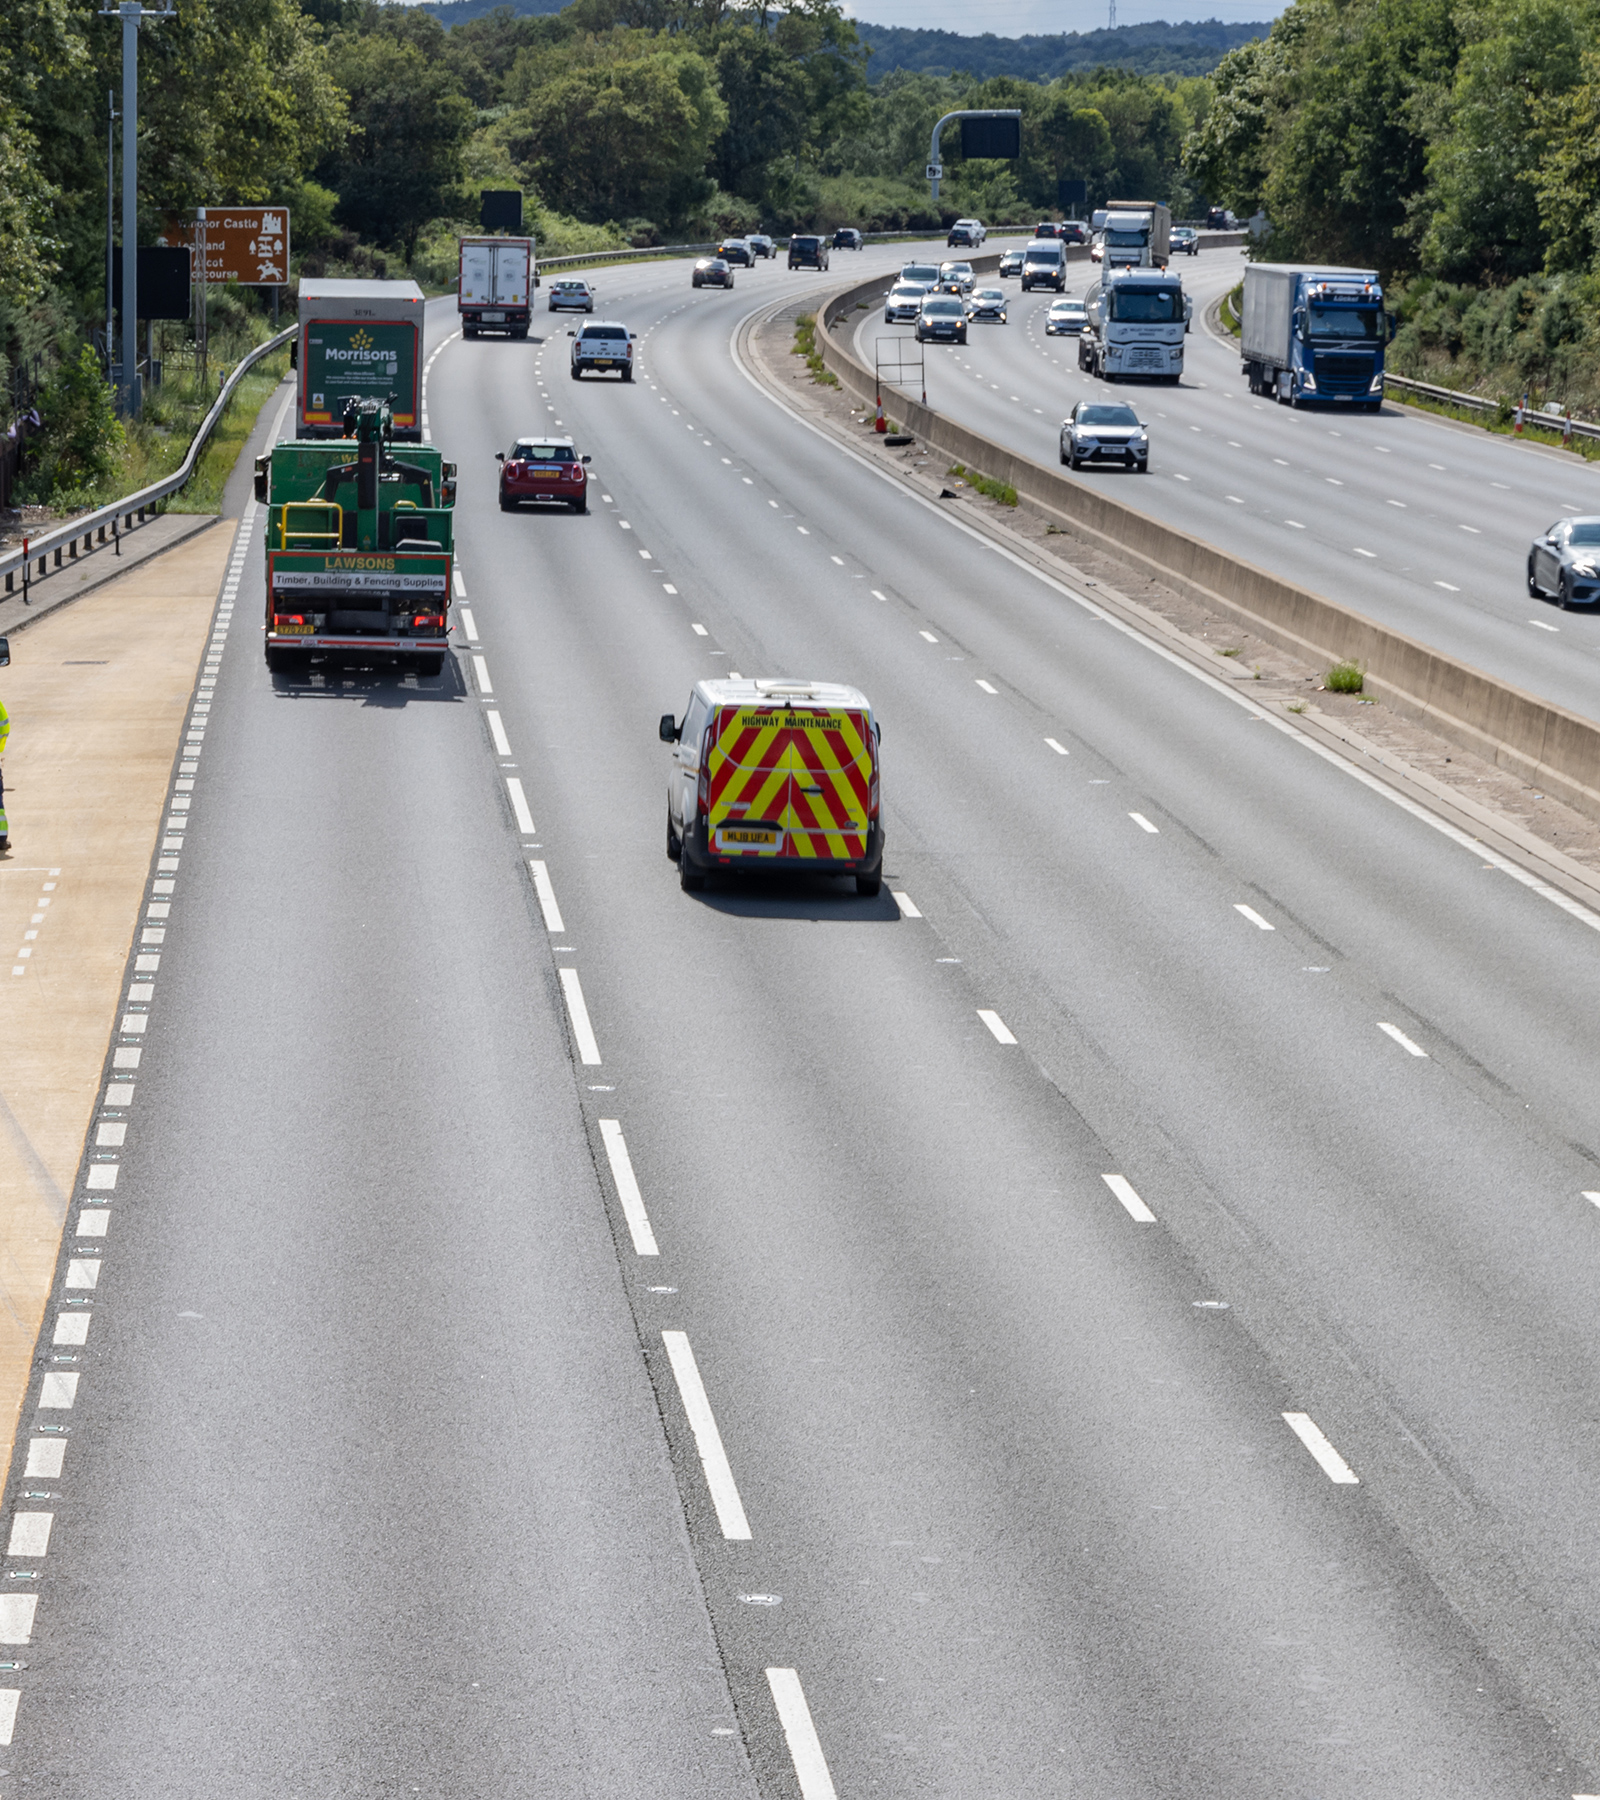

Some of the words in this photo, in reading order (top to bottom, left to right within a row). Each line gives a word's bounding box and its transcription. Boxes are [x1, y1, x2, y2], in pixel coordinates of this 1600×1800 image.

[223, 218, 258, 229] Castle
[193, 257, 224, 268] Acot
[325, 346, 398, 360] Morrisons
[325, 557, 396, 569] LAWSONS
[275, 575, 311, 585] Timber,
[313, 575, 351, 587] Building
[364, 577, 400, 588] Fencing
[403, 578, 444, 588] Supplies
[741, 716, 780, 727] HIGHWAY
[784, 716, 842, 730] MAINTENANCE
